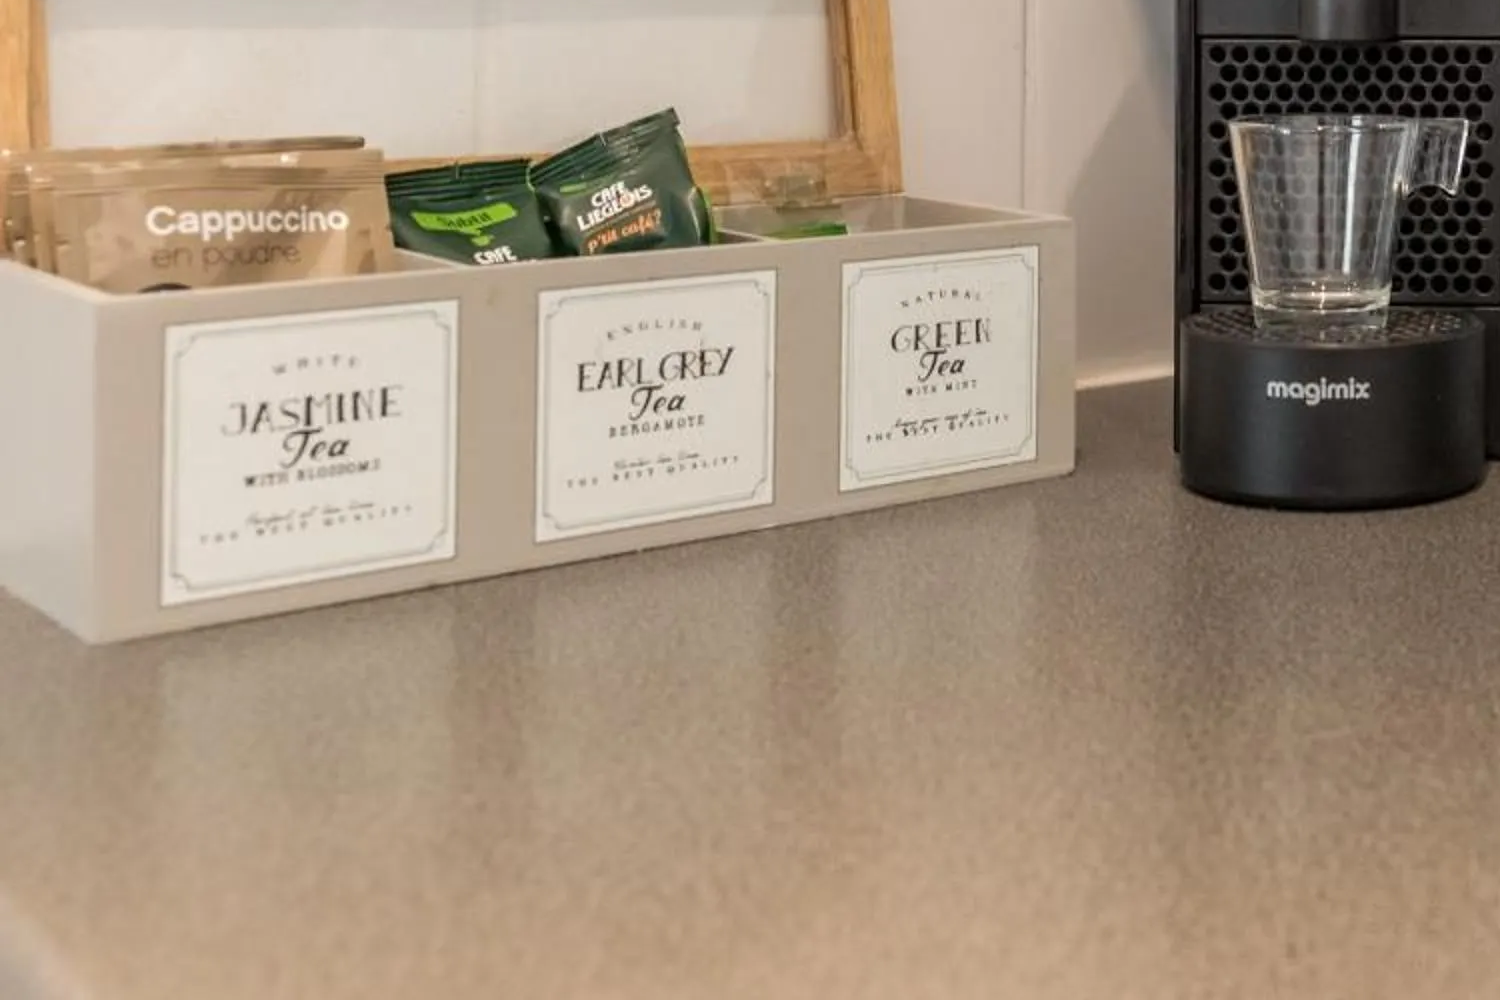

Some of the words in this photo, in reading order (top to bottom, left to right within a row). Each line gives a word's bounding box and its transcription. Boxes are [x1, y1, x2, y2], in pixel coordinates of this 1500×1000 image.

[145, 205, 350, 241] Cappuccino
[151, 246, 193, 268] en
[202, 240, 302, 272] poudre
[900, 287, 983, 308] NATURAL
[606, 318, 704, 341] ENGLISH
[890, 317, 992, 353] GREEN
[576, 356, 655, 393] EARL
[658, 345, 735, 383] GREY
[917, 348, 966, 382] Tea
[628, 384, 687, 422] Tea
[1266, 376, 1371, 407] magimix
[221, 384, 405, 436] JASMINE
[609, 414, 706, 439] BERGAMOTE
[278, 427, 351, 469] Tea
[243, 471, 290, 487] WITH
